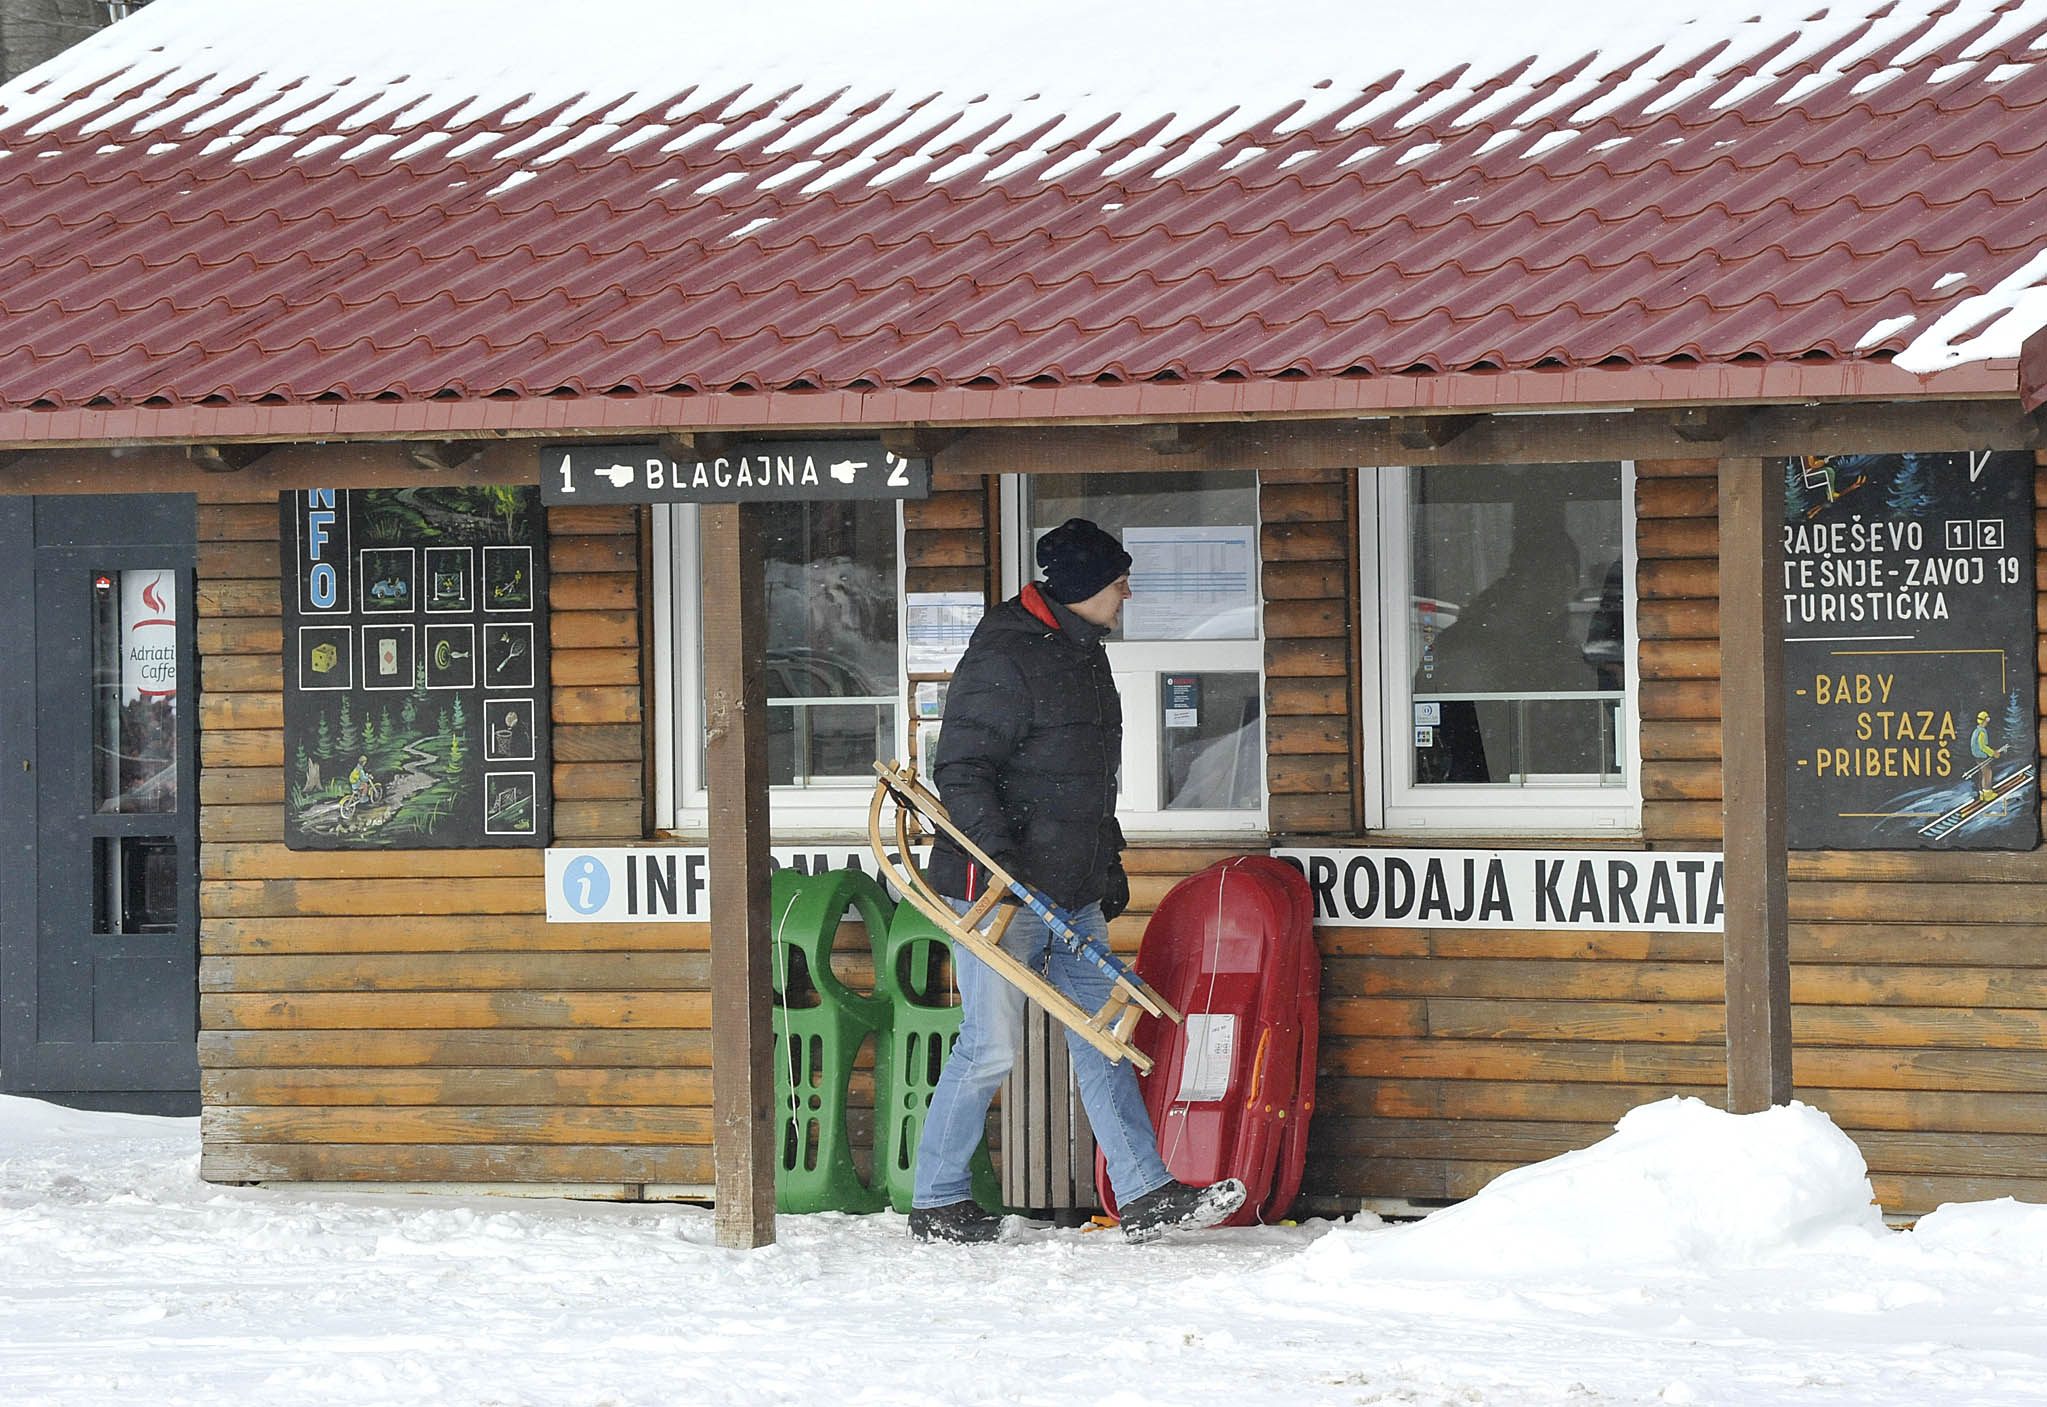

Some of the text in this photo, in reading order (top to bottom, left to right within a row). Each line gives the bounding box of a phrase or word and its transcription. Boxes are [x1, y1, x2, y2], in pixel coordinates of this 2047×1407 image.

[560, 454, 576, 493] 1
[646, 456, 819, 490] BLAGAJNA
[1997, 556, 2020, 584] 19
[1784, 585, 1950, 624] TURISTIČKA
[1816, 673, 1894, 705] BABY
[1856, 711, 1957, 741] STAZA
[1816, 740, 1951, 777] PRIBENIŠ
